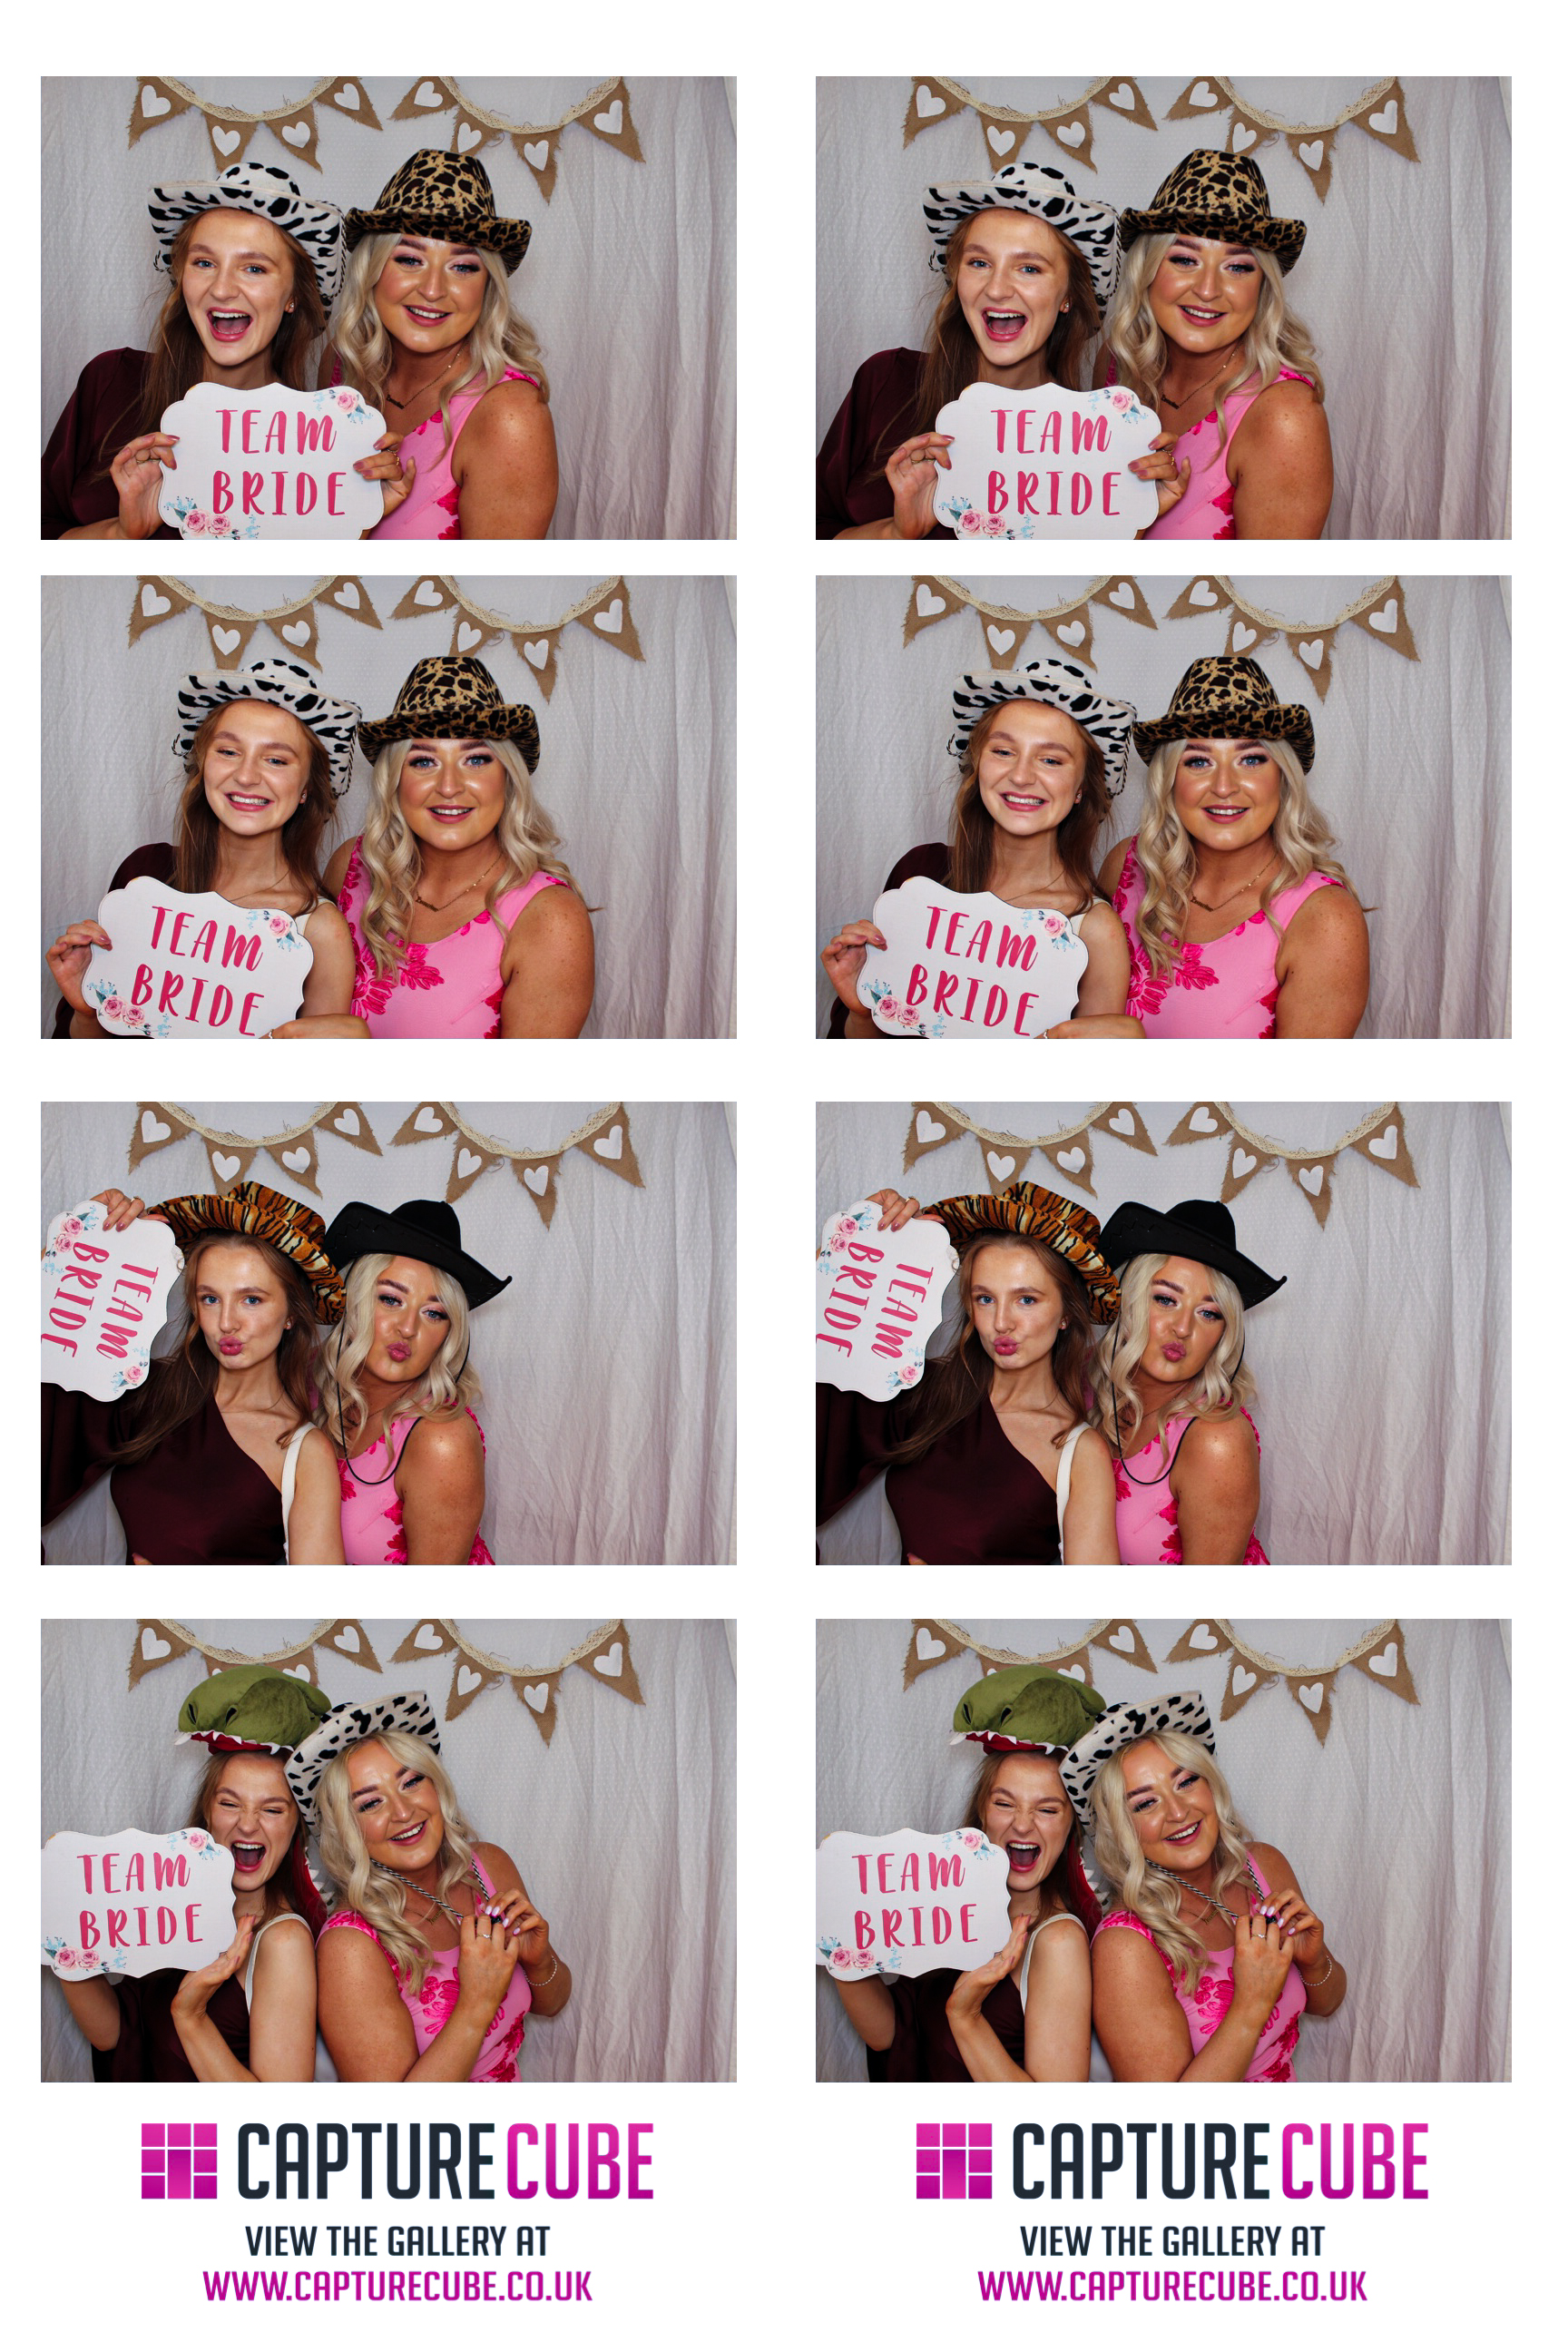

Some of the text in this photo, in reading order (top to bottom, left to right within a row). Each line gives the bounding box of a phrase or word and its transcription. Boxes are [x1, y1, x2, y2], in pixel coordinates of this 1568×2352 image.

[215, 409, 338, 455] TEAM
[990, 409, 1112, 455] TEAM
[211, 469, 348, 516] BRIDE
[986, 469, 1122, 516] BRIDE
[152, 905, 265, 972] TEAM
[926, 905, 1040, 972] TEAM
[130, 963, 265, 1037] BRIDE
[905, 963, 1040, 1037] BRIDE
[41, 1241, 111, 1358] BRIDE
[95, 1262, 160, 1360] TEAM
[816, 1241, 886, 1358] BRIDE
[870, 1262, 935, 1360] TEAM
[76, 1851, 191, 1895] TEAM
[851, 1851, 966, 1895] TEAM
[78, 1903, 204, 1950] BRIDE
[853, 1903, 979, 1950] BRIDE
